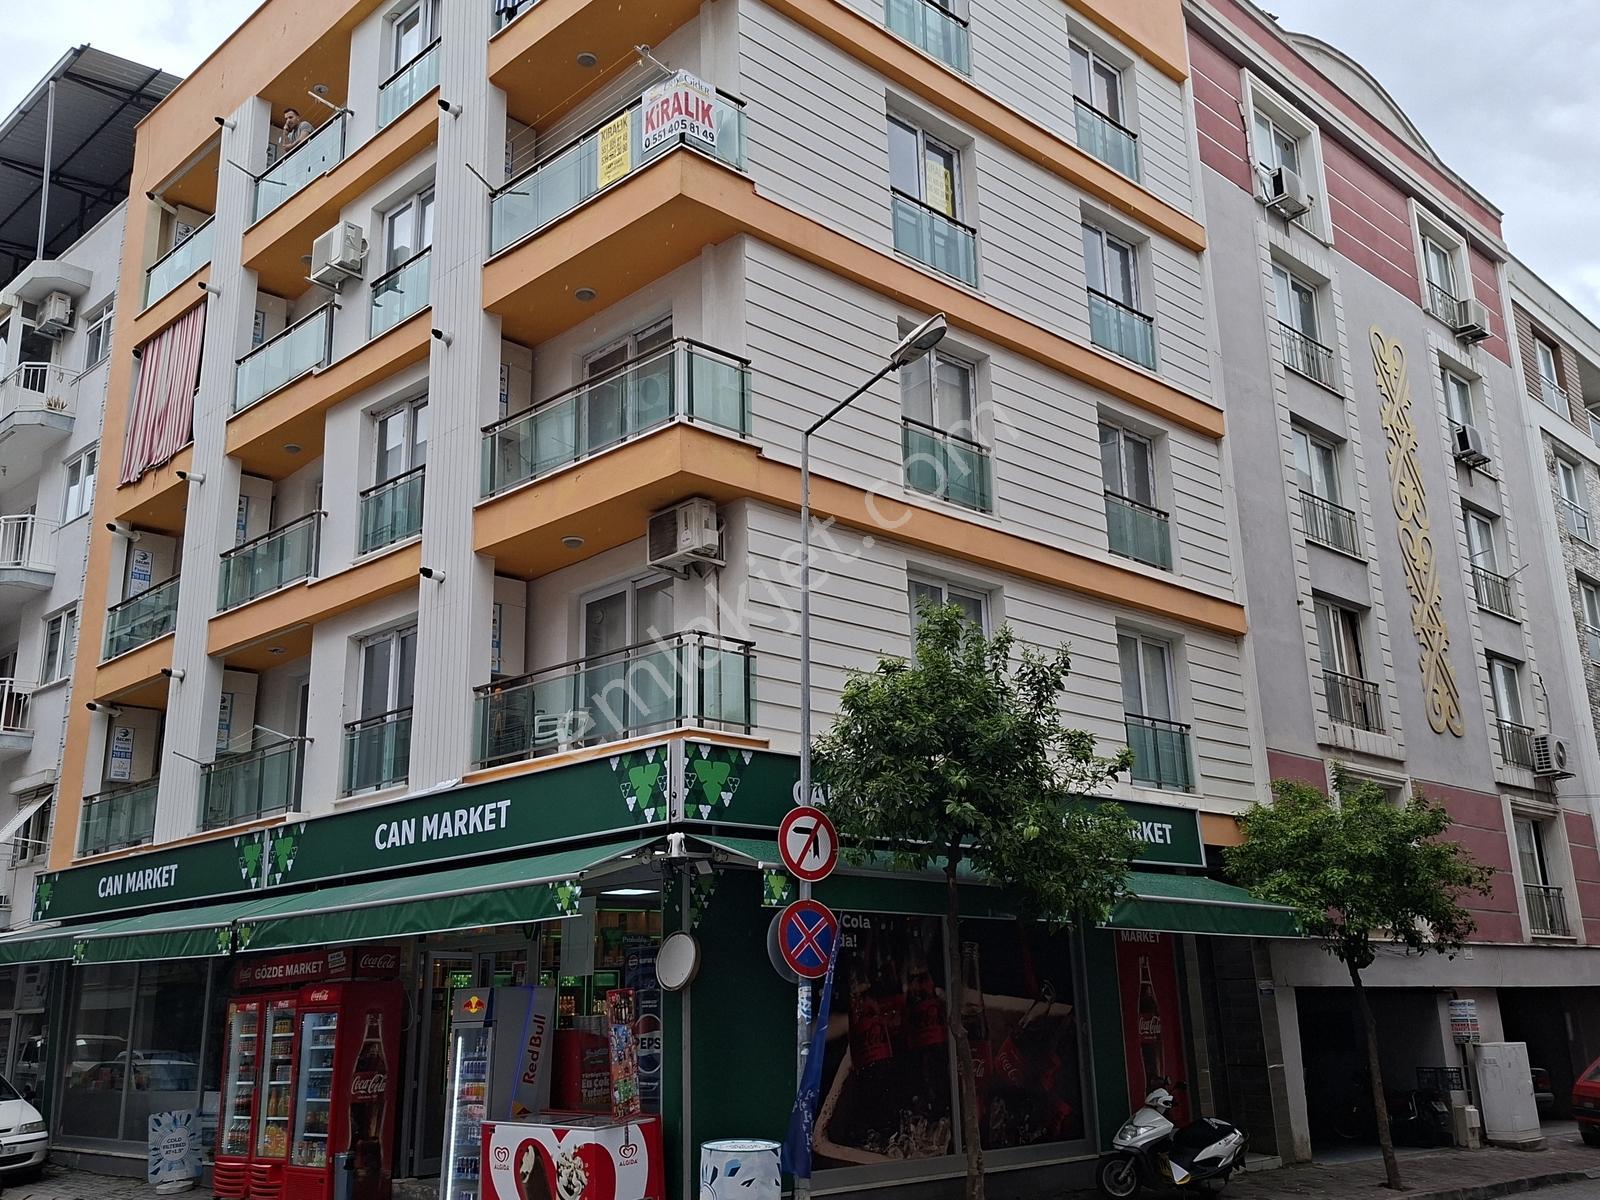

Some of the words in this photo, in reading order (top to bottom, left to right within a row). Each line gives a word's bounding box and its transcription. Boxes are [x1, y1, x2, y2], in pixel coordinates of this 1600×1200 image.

[644, 137, 651, 148] 0
[652, 129, 666, 145] 551
[668, 119, 687, 135] 405
[689, 122, 700, 135] 81
[702, 129, 715, 143] 49
[374, 818, 416, 850] CAN
[421, 799, 511, 843] MARKET
[98, 873, 124, 898] CAN
[125, 864, 178, 894] MARKET
[842, 914, 871, 929] Cola
[1120, 929, 1160, 943] MARKET
[254, 964, 284, 980] GÖZDE
[285, 960, 324, 977] MARKET
[619, 1158, 638, 1167] ALGIDA
